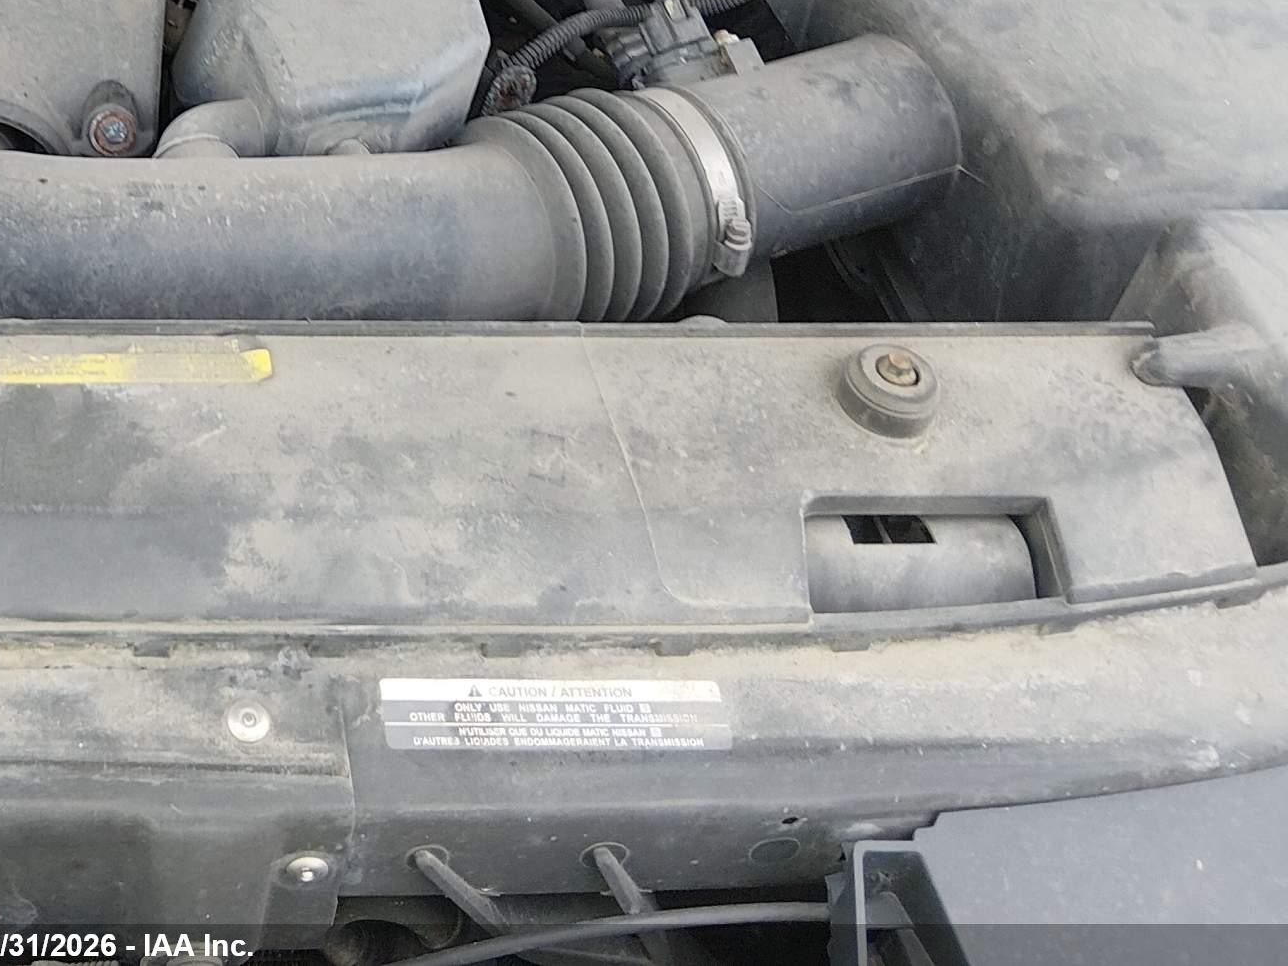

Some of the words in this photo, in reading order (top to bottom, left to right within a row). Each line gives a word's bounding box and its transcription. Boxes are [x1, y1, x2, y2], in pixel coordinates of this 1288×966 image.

[488, 686, 547, 697] CAUTION
[561, 687, 633, 698] ATTENTION
[454, 702, 483, 713] ONLY
[489, 703, 510, 713] USE
[518, 703, 558, 713] NISSAN
[565, 703, 596, 713] MATIC
[604, 703, 634, 714] FLUID
[409, 712, 446, 722] OTHER
[502, 713, 527, 723] WILL
[535, 713, 581, 723] DAMAGE
[590, 713, 611, 723] THE
[619, 713, 698, 724] TRANSMISSION
[508, 727, 528, 736] QUE
[529, 727, 544, 736] DU
[545, 727, 581, 737] LIQUIDE
[582, 728, 610, 737] MATIC
[612, 728, 646, 737] NISSAN
[464, 736, 509, 746] LIQUIDES
[514, 737, 611, 747] ENDOMMAGERAIENT
[614, 737, 626, 747] LA
[631, 737, 704, 747] TRANSMISSION
